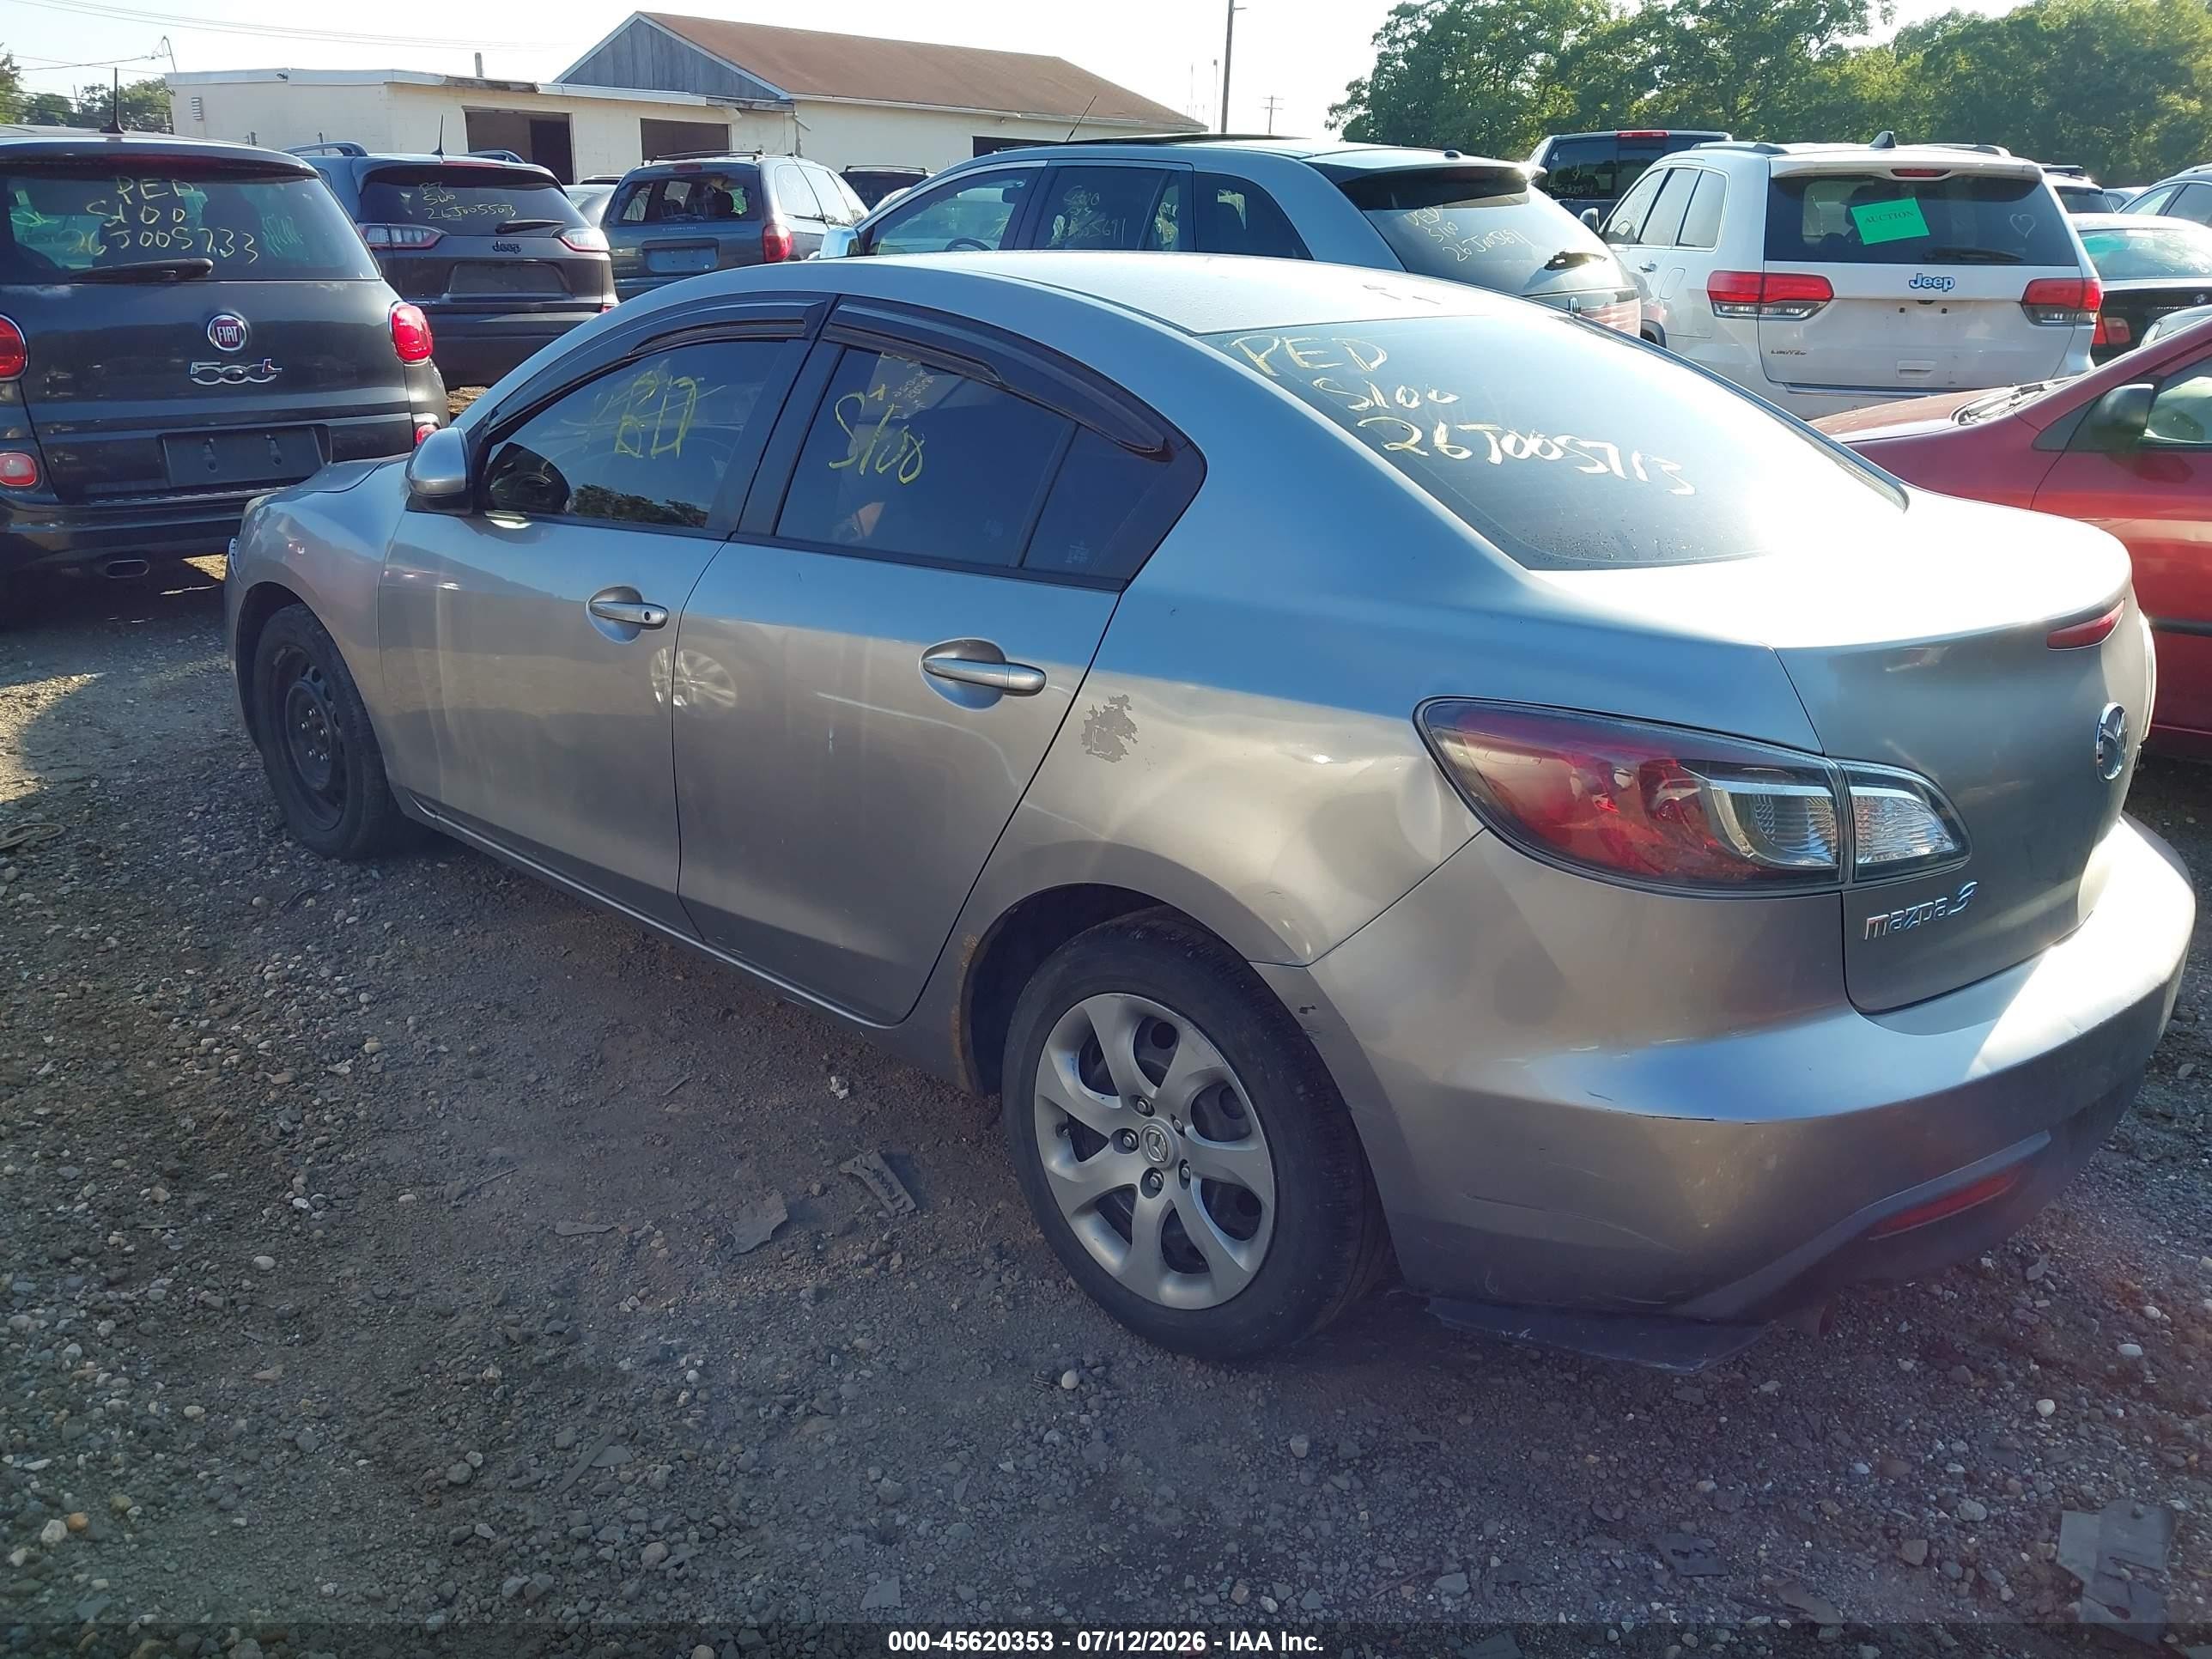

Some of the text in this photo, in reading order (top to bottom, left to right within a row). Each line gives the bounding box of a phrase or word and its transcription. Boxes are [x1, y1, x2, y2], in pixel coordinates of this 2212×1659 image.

[1864, 210, 1915, 223] AUCTION
[492, 240, 521, 254] Jeep
[1909, 273, 1955, 292] Jeep
[216, 325, 238, 343] FIAT
